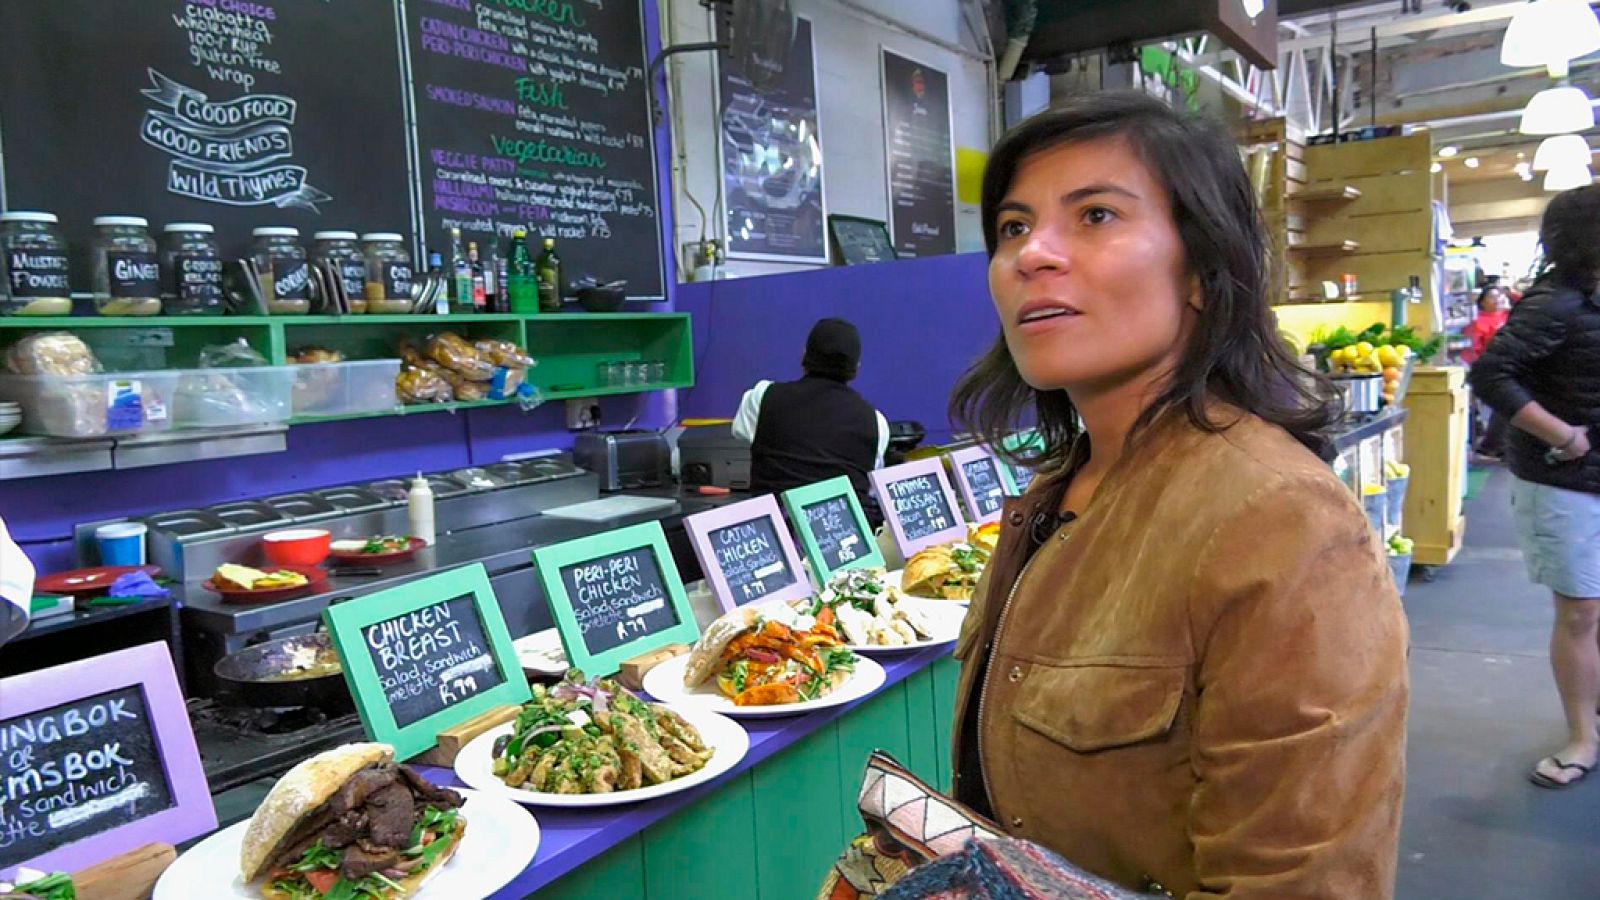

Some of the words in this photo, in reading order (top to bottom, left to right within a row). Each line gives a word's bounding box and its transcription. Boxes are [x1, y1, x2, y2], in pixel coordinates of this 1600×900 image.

[515, 76, 568, 109] Fish
[186, 99, 242, 125] GOOD
[243, 100, 289, 119] FOOD
[146, 118, 201, 154] GOOD
[205, 133, 287, 161] FRIENDS
[490, 134, 607, 169] Vegetarian
[221, 169, 297, 200] Thymes
[717, 532, 770, 567] CHICKEN
[574, 556, 639, 589] PERI-PERI
[578, 575, 642, 604] CHICKEN
[368, 602, 451, 649] CHICKEN
[379, 620, 462, 670] BREAST
